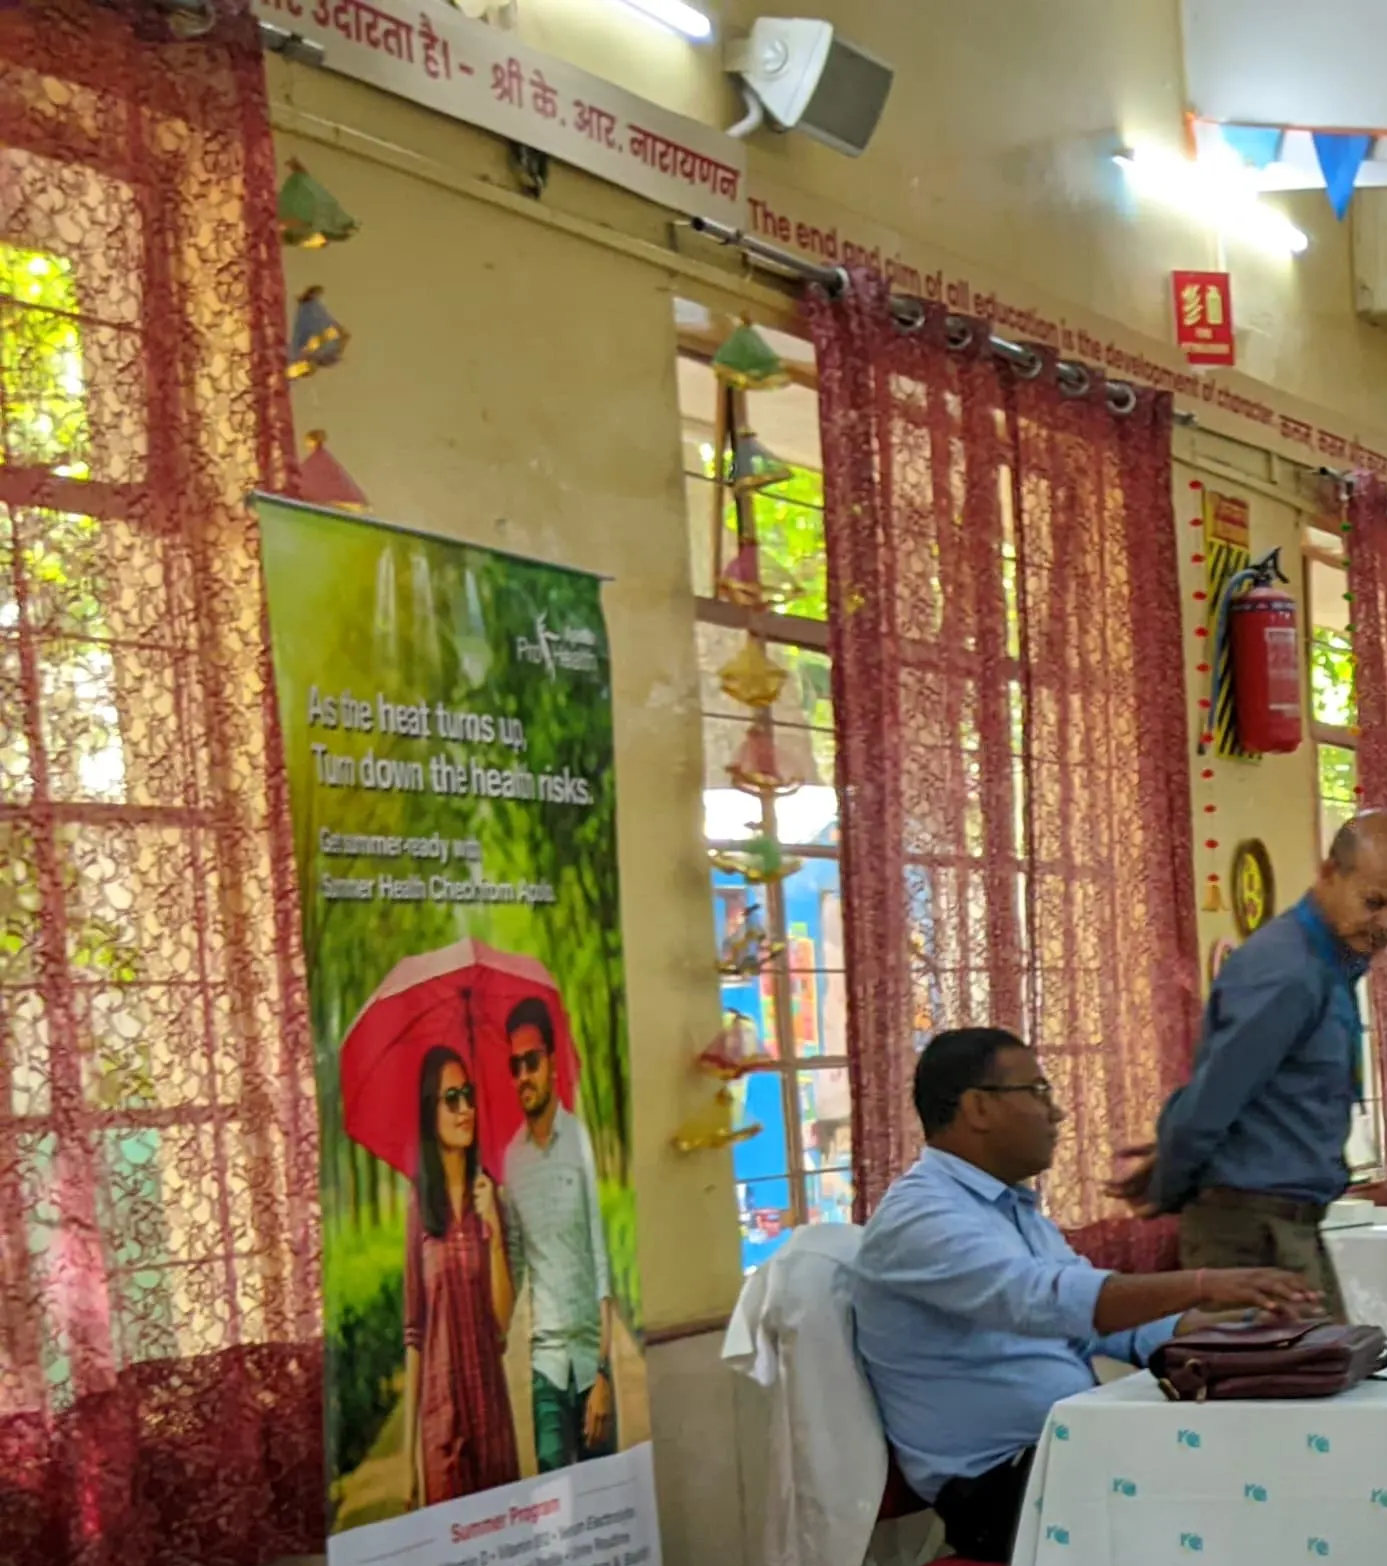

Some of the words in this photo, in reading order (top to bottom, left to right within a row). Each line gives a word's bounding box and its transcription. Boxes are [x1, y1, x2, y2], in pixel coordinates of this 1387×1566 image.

[747, 196, 791, 243] The
[796, 221, 838, 260] end
[308, 684, 338, 728] As
[340, 688, 373, 732] the
[376, 691, 431, 737] heat
[435, 701, 496, 743] turns
[359, 747, 424, 792] down
[430, 752, 468, 794] the
